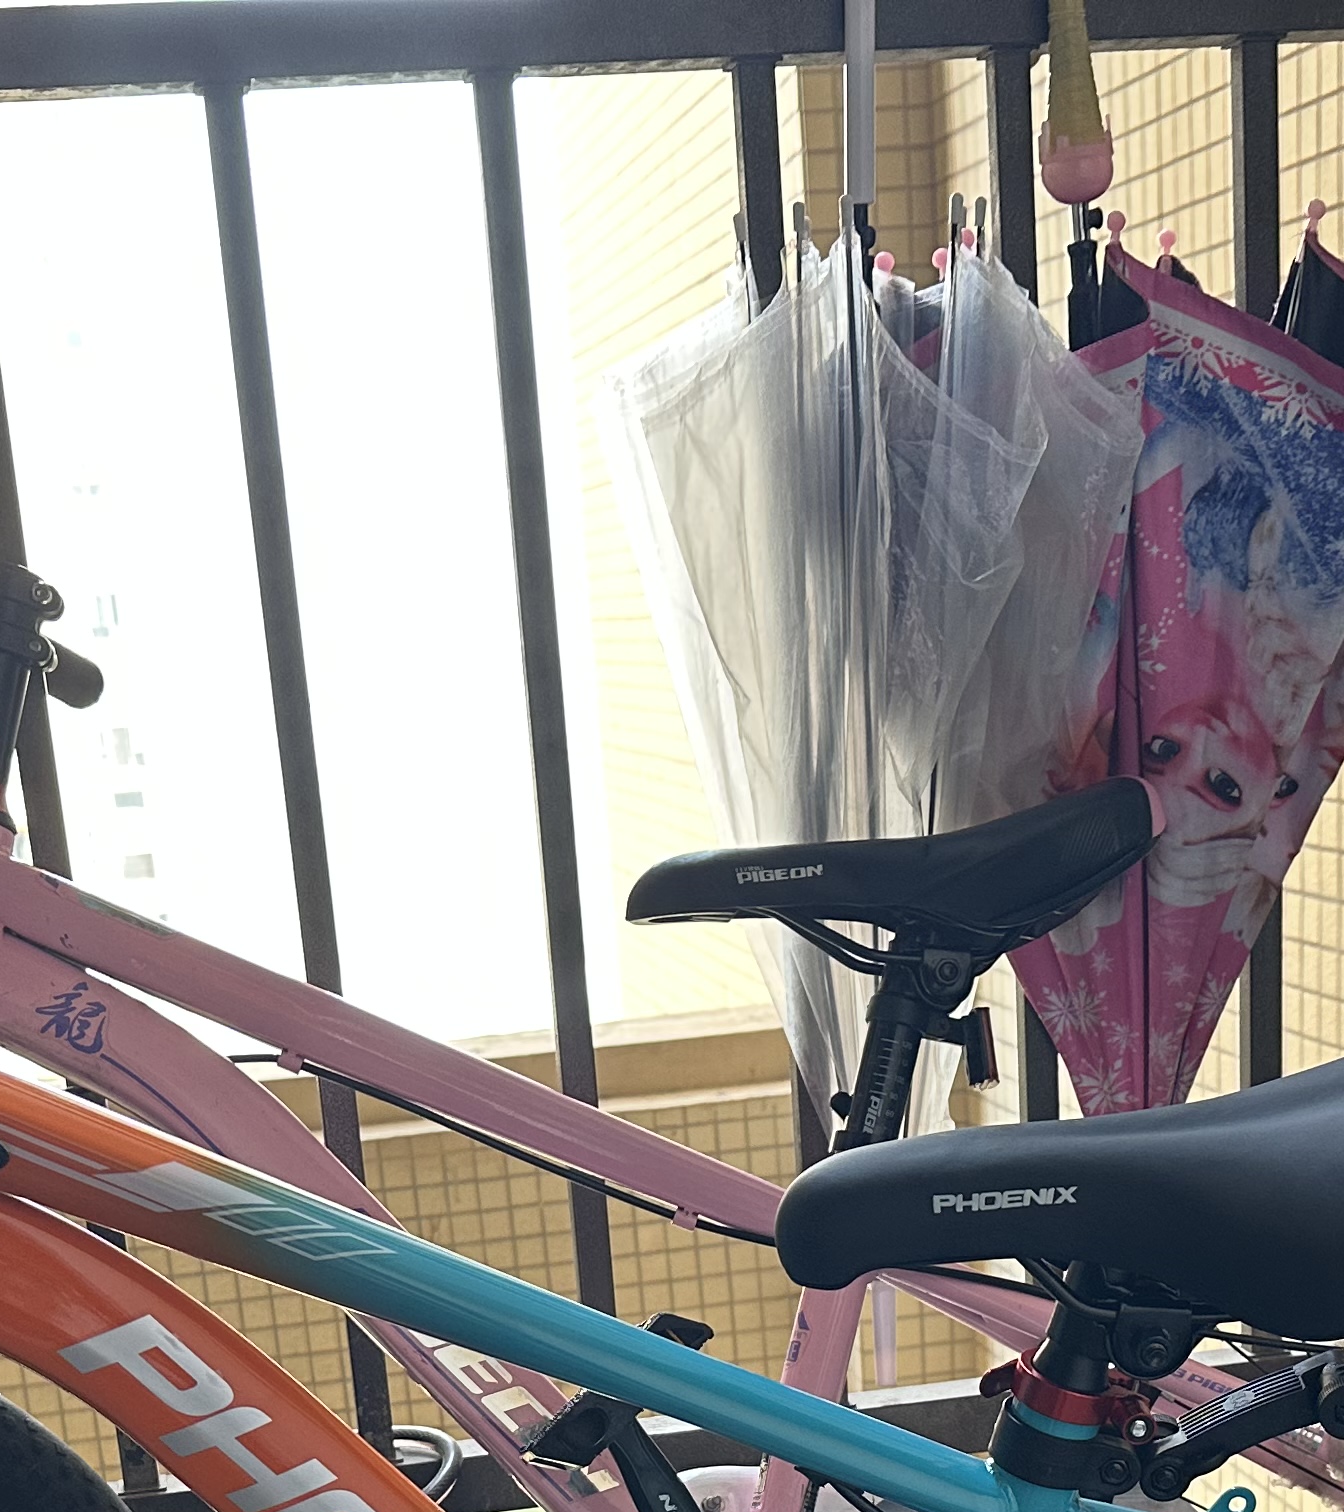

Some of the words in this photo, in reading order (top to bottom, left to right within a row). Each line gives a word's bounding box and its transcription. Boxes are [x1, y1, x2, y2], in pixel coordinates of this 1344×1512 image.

[736, 864, 824, 884] PIGEON
[932, 1184, 1078, 1214] PHOENIX
[1187, 1373, 1234, 1394] PIG
